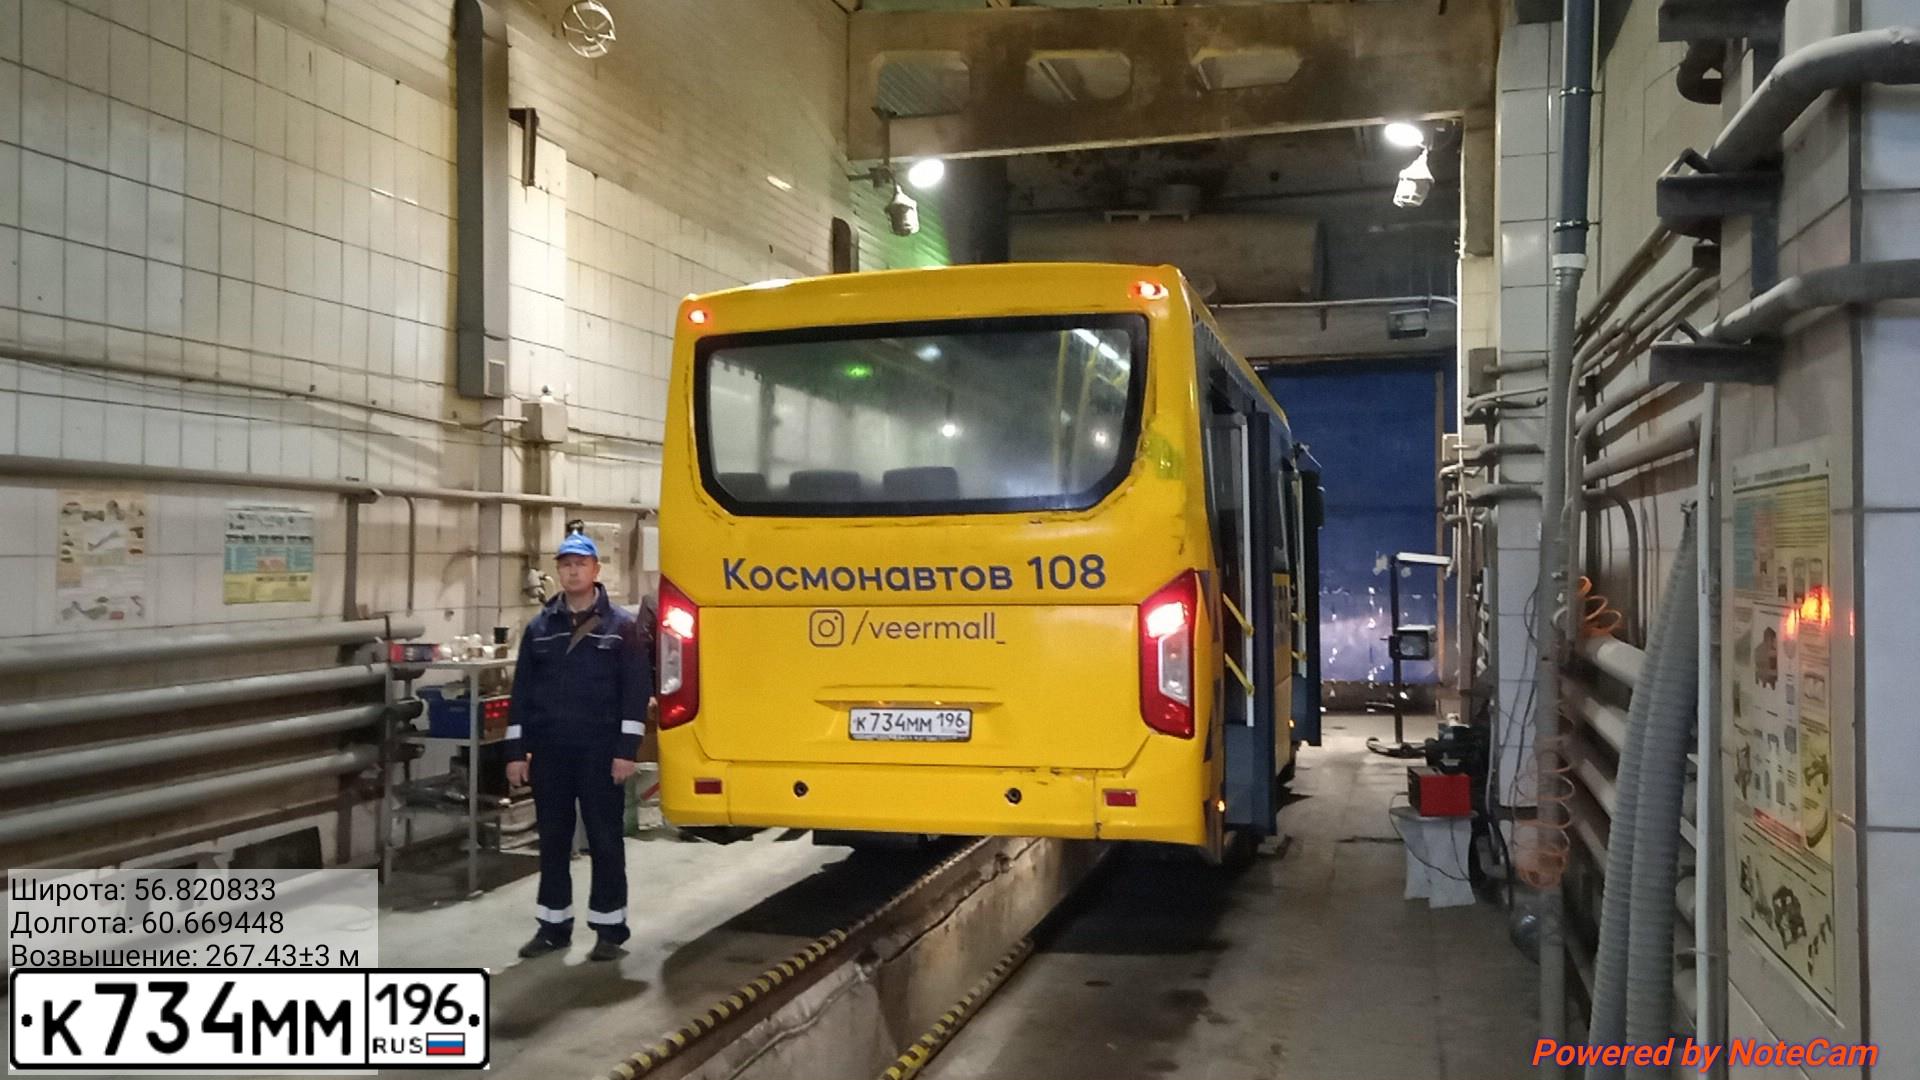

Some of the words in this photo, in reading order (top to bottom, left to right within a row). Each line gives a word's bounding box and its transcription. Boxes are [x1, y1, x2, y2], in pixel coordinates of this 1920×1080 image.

[722, 556, 1013, 592] Космонавтов
[1027, 554, 1107, 590] 108
[935, 712, 967, 729] 196
